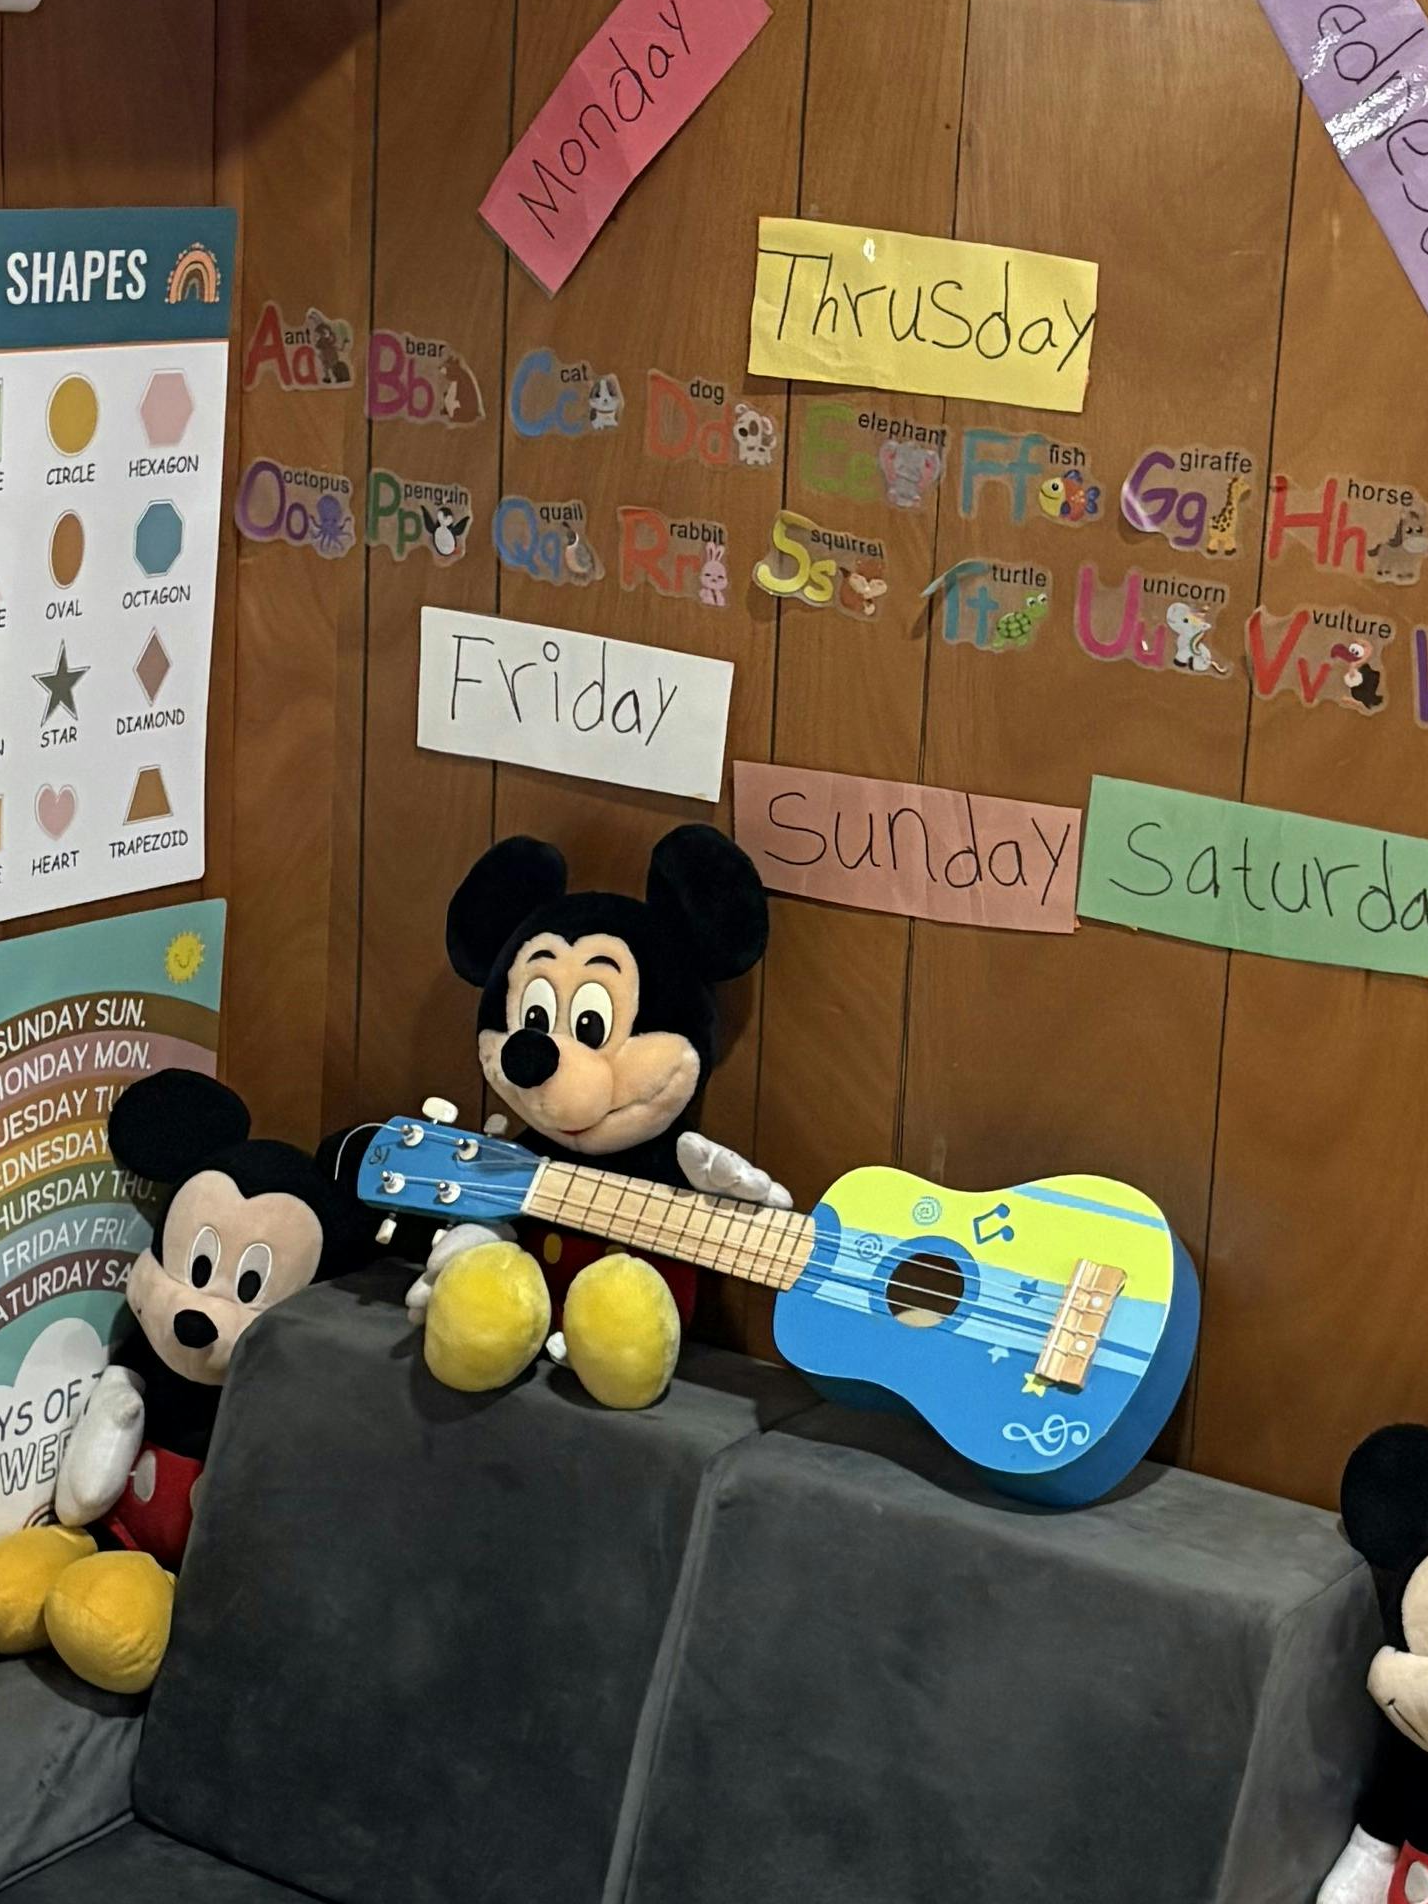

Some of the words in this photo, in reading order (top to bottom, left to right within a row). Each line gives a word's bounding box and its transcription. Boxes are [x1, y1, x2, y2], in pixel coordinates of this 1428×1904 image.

[6, 249, 147, 305] SHAPES
[759, 248, 1095, 372] Thrusday
[404, 336, 446, 358] bear
[559, 364, 589, 384] cat
[857, 411, 948, 447] elephant
[1179, 448, 1253, 475] giraffe
[281, 468, 351, 495] octopus
[1346, 478, 1413, 508] horse
[809, 527, 884, 560] squirrel
[450, 634, 678, 747] Friday
[116, 708, 186, 735] DIAMOND
[109, 830, 189, 859] TRAPEZOID
[764, 792, 1071, 907] Sunday
[94, 997, 146, 1029] SUN.
[1, 1217, 90, 1279] FRIDAY
